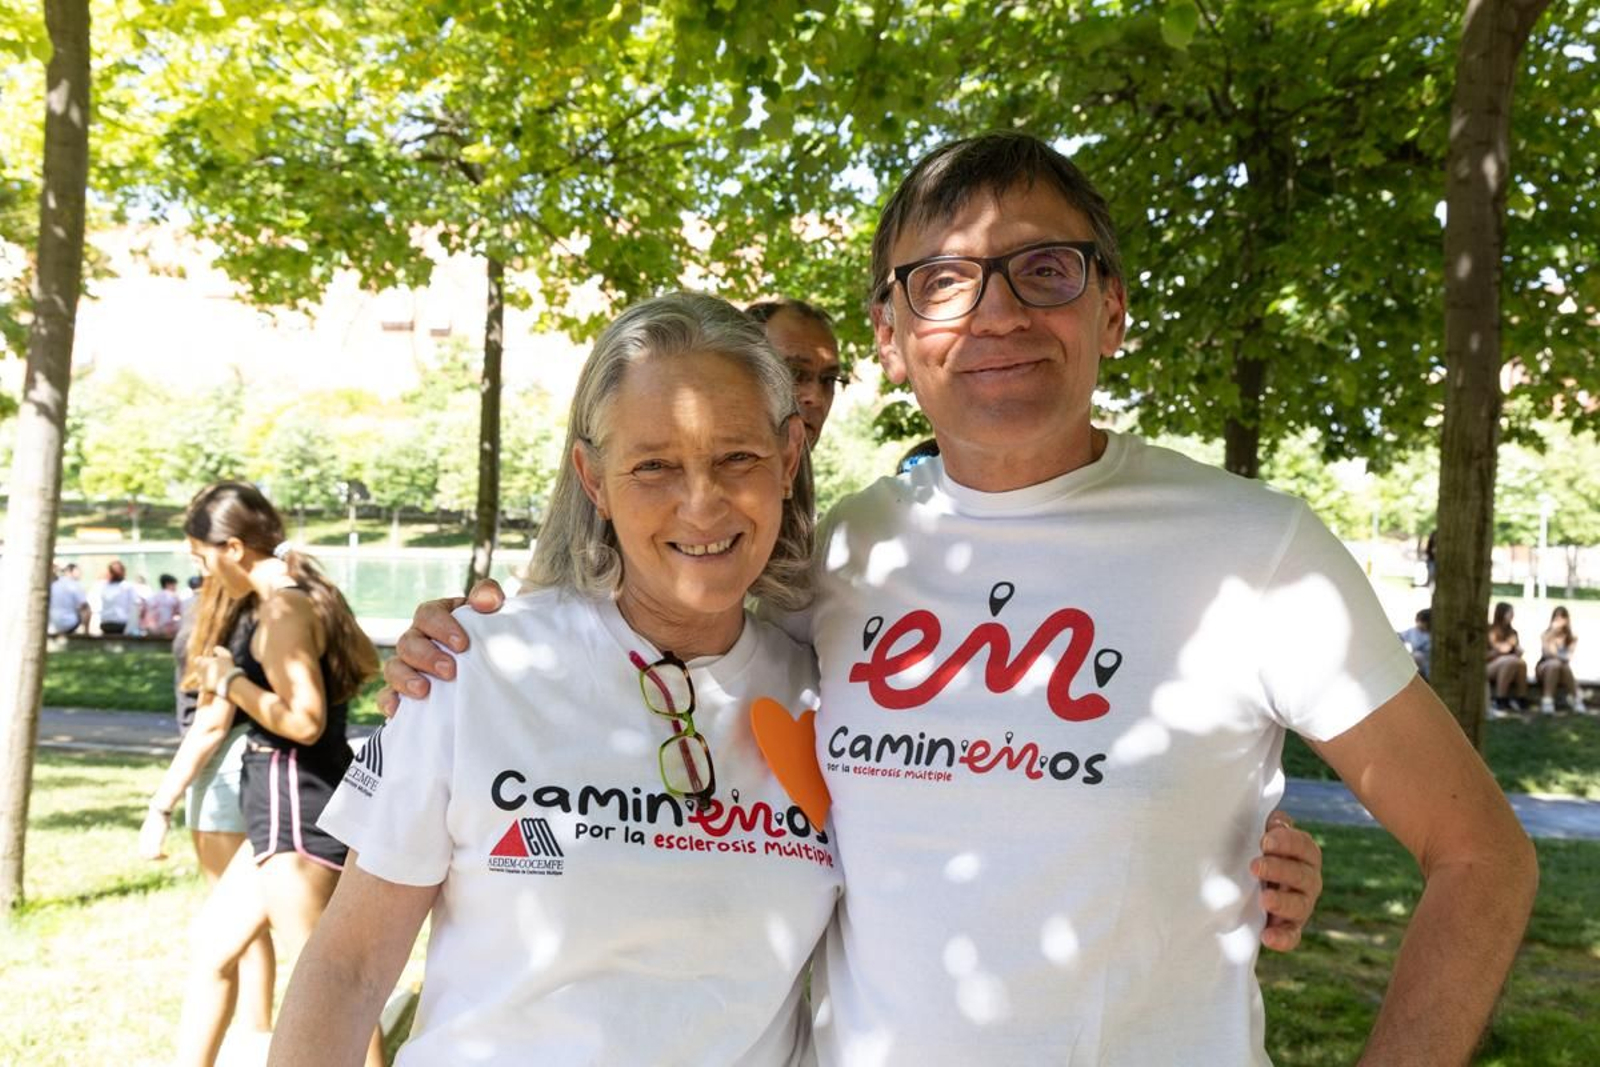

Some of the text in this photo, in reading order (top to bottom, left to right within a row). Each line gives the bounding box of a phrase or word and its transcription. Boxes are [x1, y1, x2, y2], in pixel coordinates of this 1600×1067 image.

[842, 763, 850, 773] la
[852, 765, 901, 778] esclerosis
[575, 822, 616, 841] por
[625, 825, 645, 846] la
[653, 833, 757, 854] esclerosis
